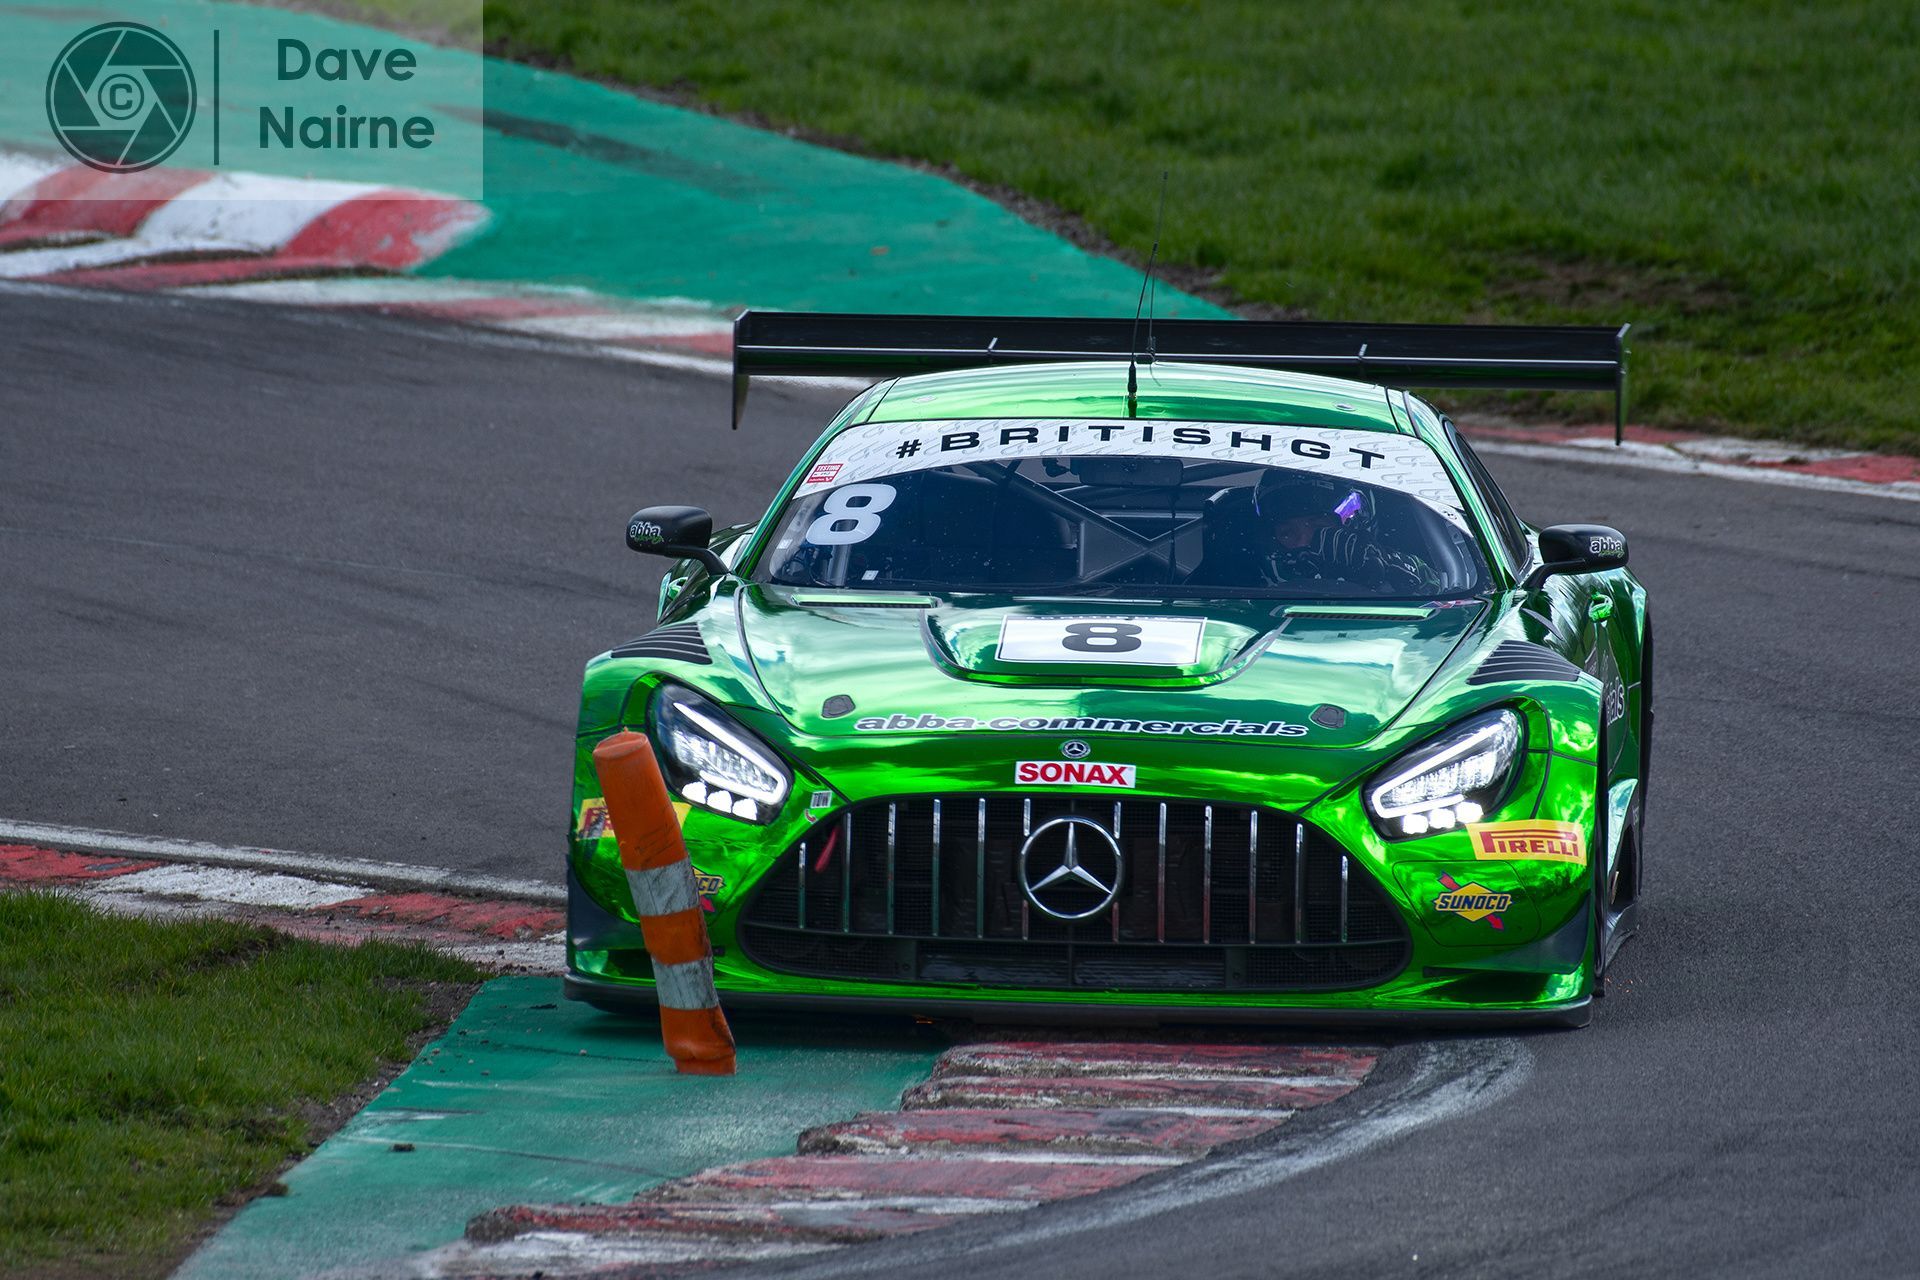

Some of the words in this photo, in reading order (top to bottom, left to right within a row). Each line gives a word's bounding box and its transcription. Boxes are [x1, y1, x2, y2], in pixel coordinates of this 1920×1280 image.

[896, 425, 1385, 469] #BRITISHGT
[805, 483, 897, 546] 8
[630, 521, 661, 538] abba
[1590, 536, 1623, 553] abba
[1061, 622, 1143, 653] 8
[1018, 762, 1128, 785] SONAX
[1479, 829, 1579, 857] PIRELLI
[1438, 893, 1509, 910] SUNOCO
